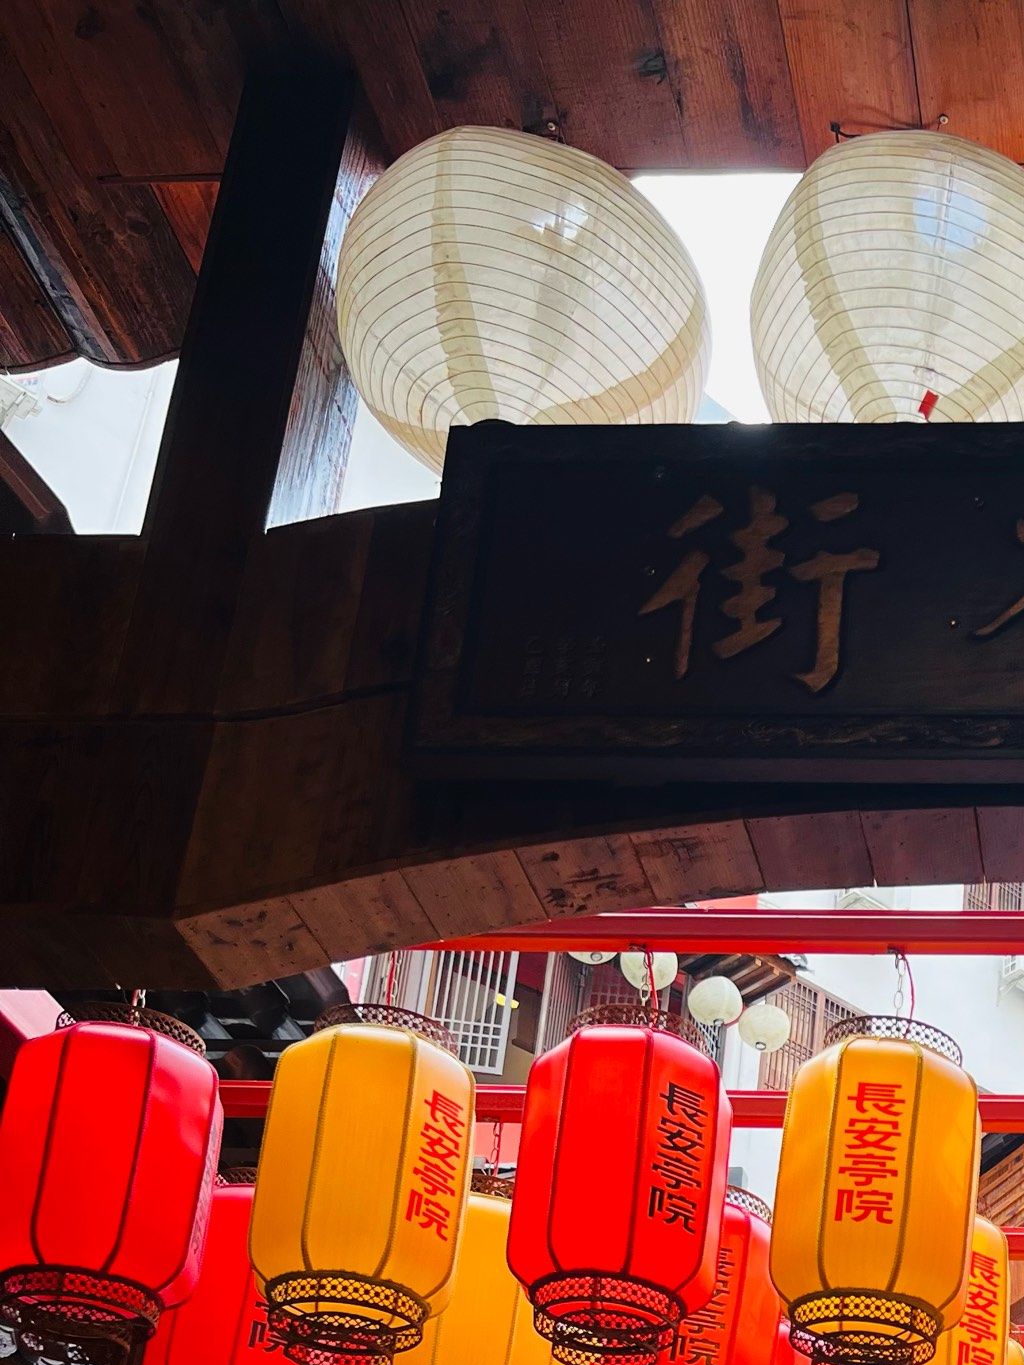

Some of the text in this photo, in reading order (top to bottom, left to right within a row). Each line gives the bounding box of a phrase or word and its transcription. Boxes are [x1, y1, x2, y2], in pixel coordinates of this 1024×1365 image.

[406, 1089, 466, 1242] 長安亭院
[648, 1081, 708, 1235] 長安亭院
[834, 1081, 907, 1224] 長安亭院
